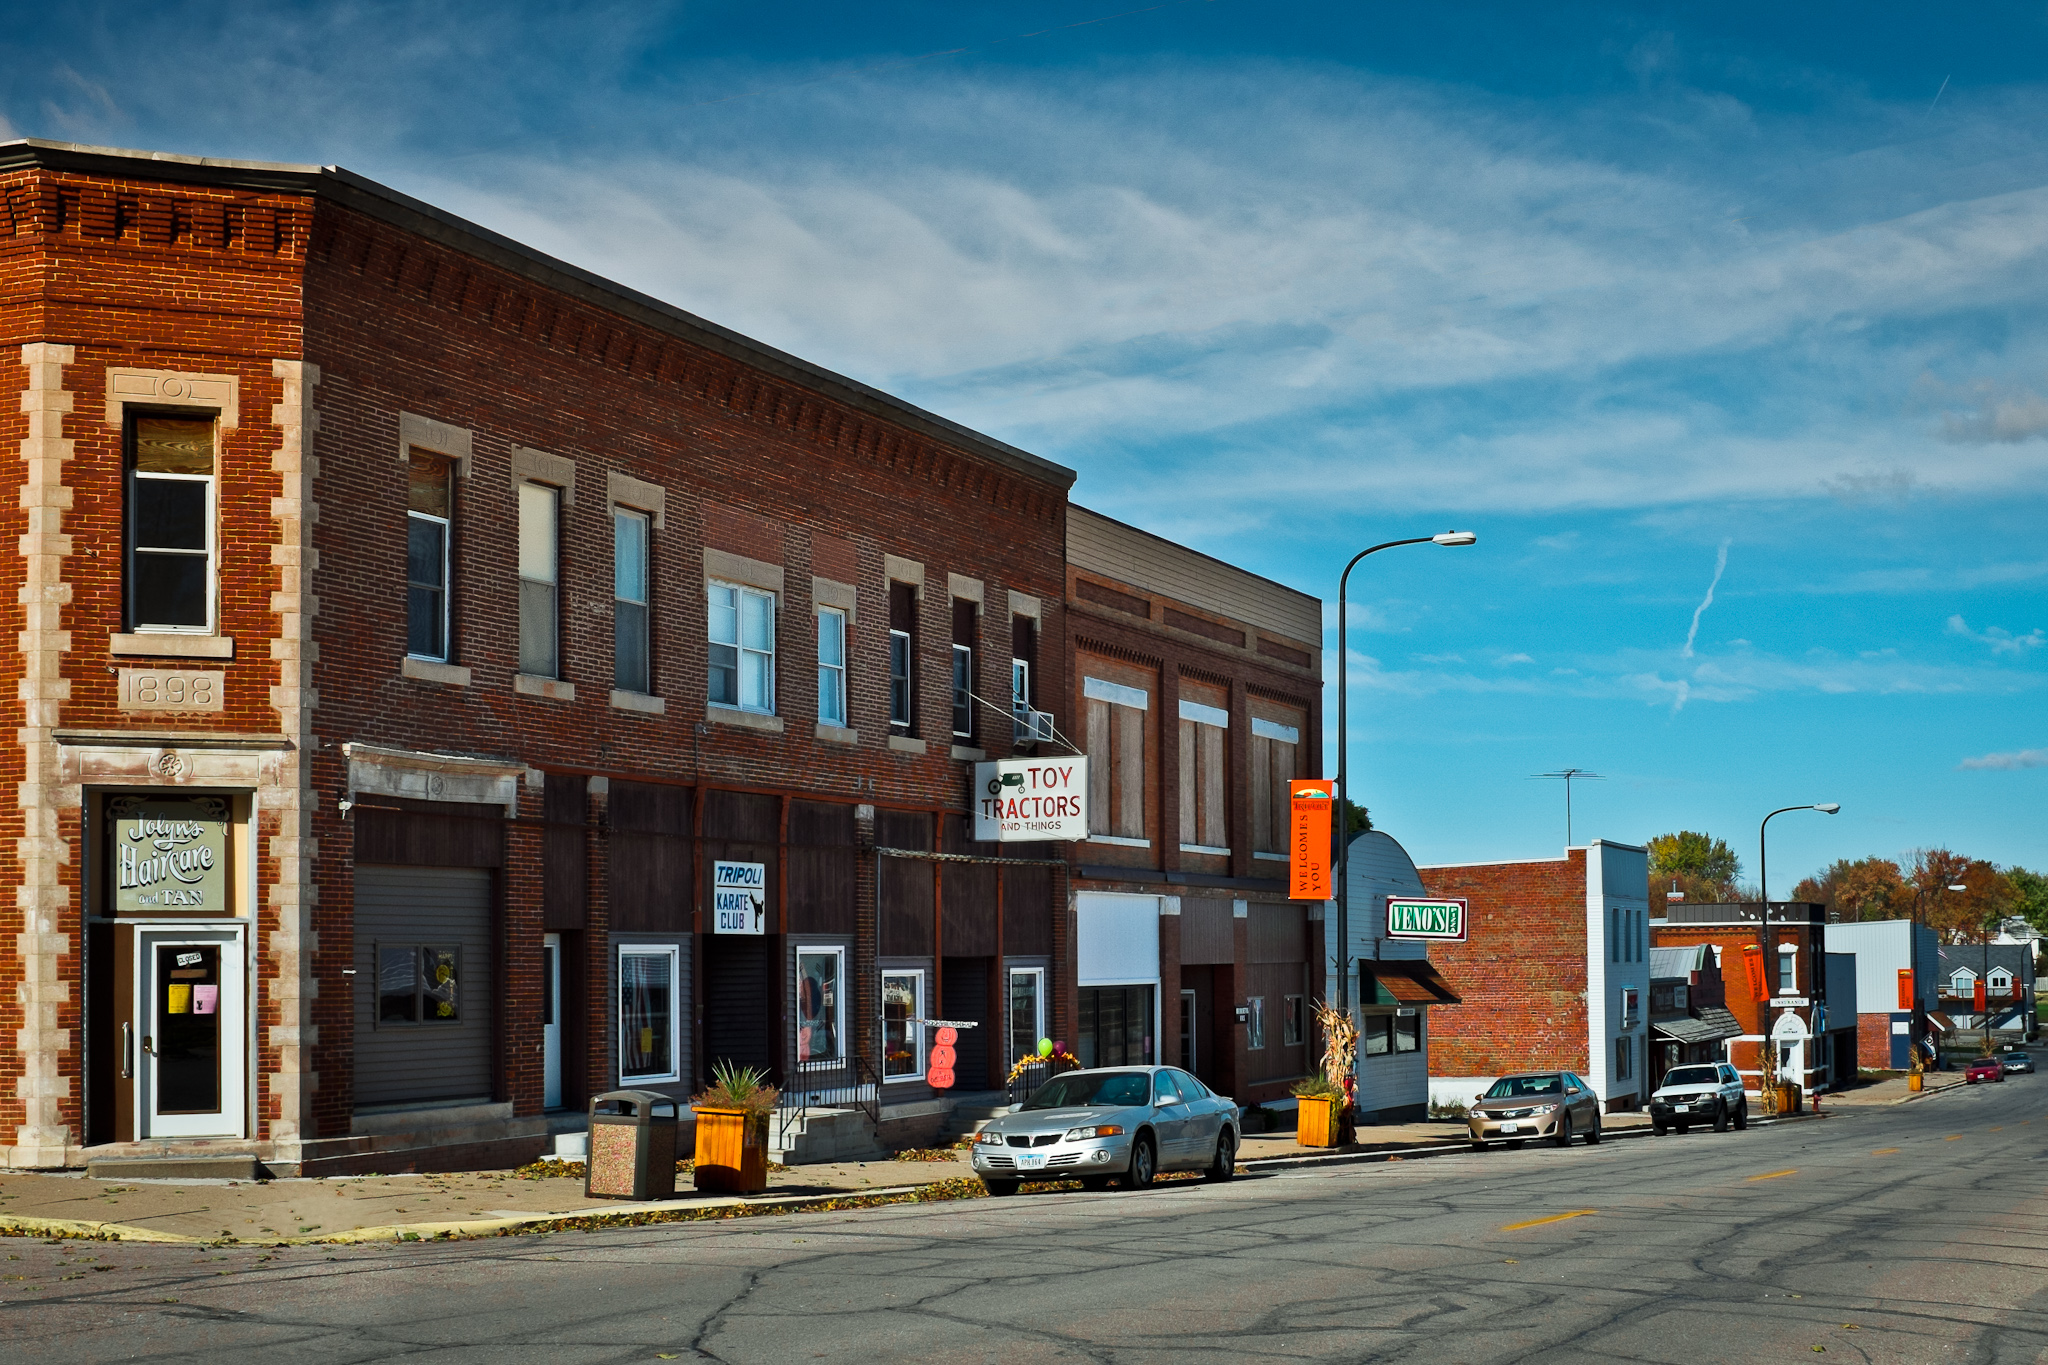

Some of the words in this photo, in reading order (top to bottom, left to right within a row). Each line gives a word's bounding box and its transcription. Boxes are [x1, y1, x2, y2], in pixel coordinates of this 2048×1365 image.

[127, 675, 213, 705] 1898
[1027, 766, 1073, 789] TOY
[981, 795, 1081, 820] TRACTORS
[128, 812, 205, 850] Jolyn's
[1001, 822, 1021, 831] AND
[1025, 821, 1062, 831] THINGS
[1299, 814, 1308, 892] WELCOMES
[717, 866, 762, 884] TRIPOLI
[1311, 862, 1320, 892] YOU
[138, 892, 159, 905] and
[161, 890, 203, 905] TAN
[717, 893, 748, 911] KARATE
[721, 912, 745, 930] CLUB
[1393, 906, 1446, 932] VENO'S
[1449, 907, 1458, 933] PIZZA
[178, 953, 201, 963] CLOSED
